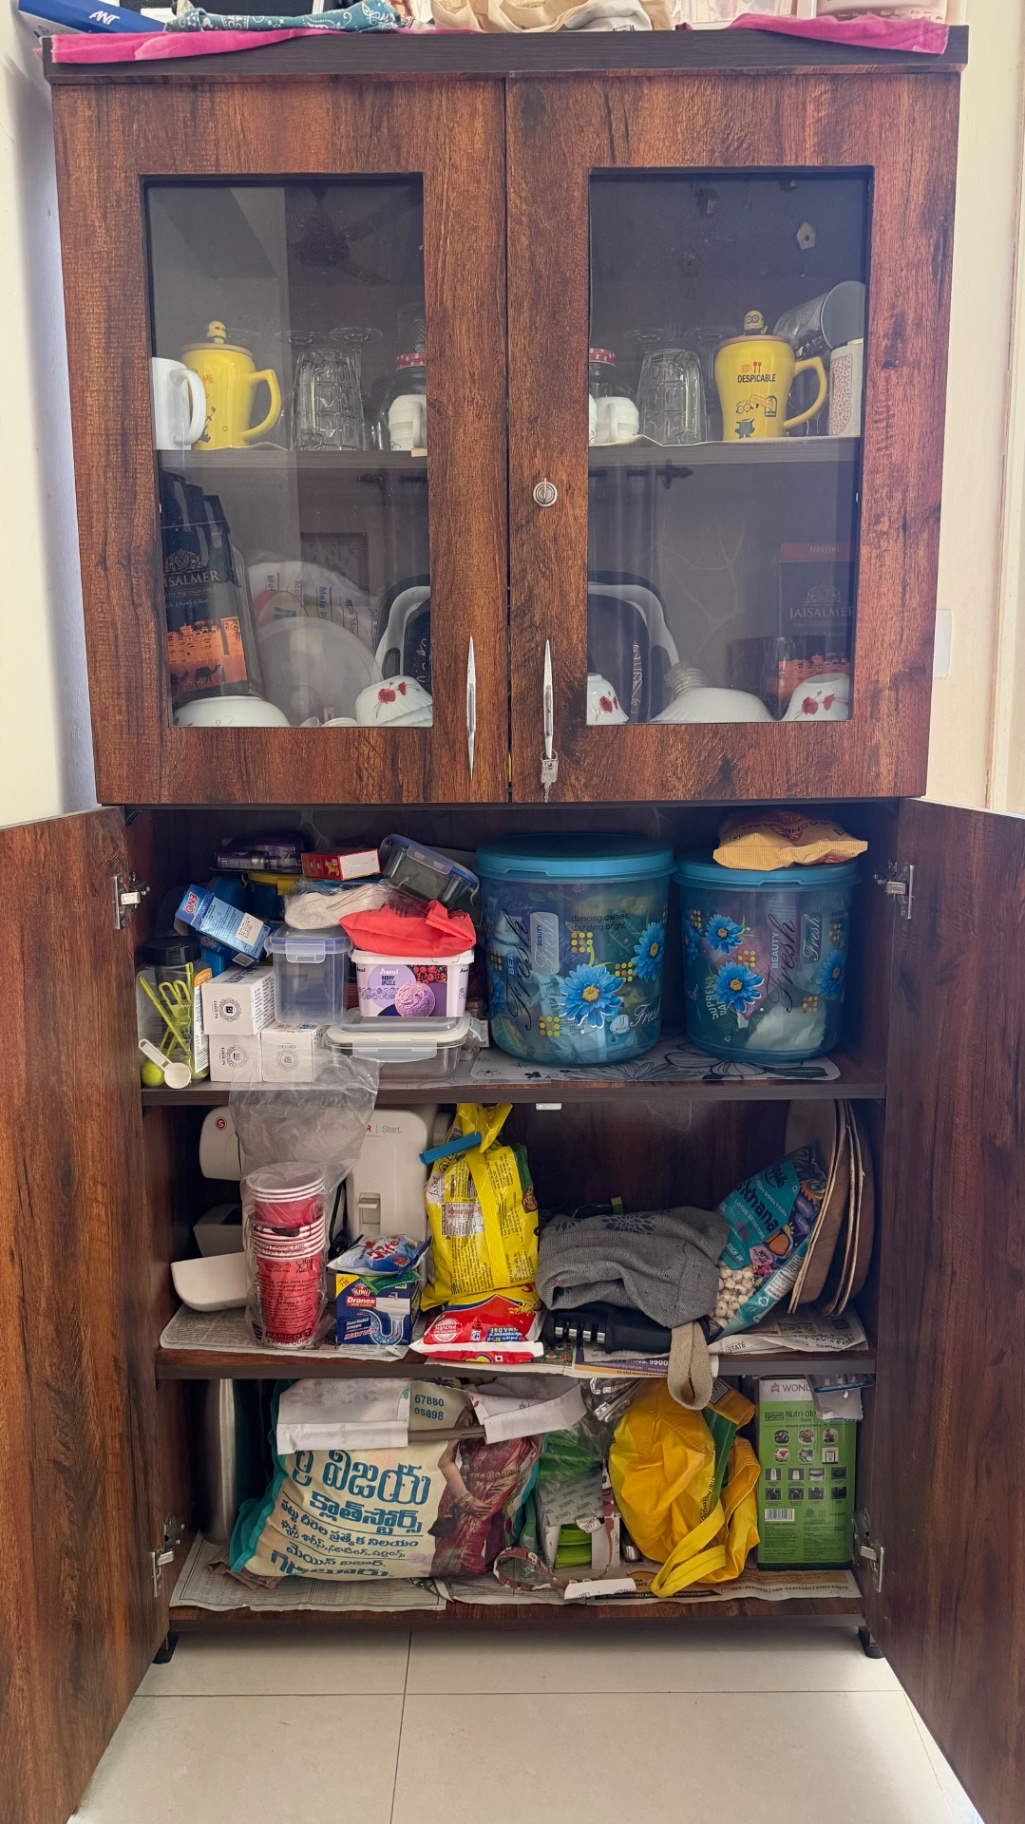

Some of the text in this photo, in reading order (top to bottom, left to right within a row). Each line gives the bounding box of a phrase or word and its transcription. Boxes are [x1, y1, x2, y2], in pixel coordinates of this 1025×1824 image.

[737, 373, 776, 384] DESPICABLE
[184, 891, 199, 915] ENO
[571, 923, 604, 932] dazzling
[534, 913, 557, 974] Fresh
[802, 913, 821, 961] Fresh
[771, 932, 779, 969] BEAUTY
[502, 907, 532, 1032] Fresh
[767, 913, 796, 1013] Fresh
[217, 1120, 224, 1128] S
[734, 1200, 749, 1216] LOTUS
[726, 1243, 739, 1255] RICH
[414, 1393, 445, 1407] 67880
[414, 1407, 444, 1421] 05898
[322, 1449, 432, 1506] విజయ
[367, 1537, 419, 1547] నిలయం
